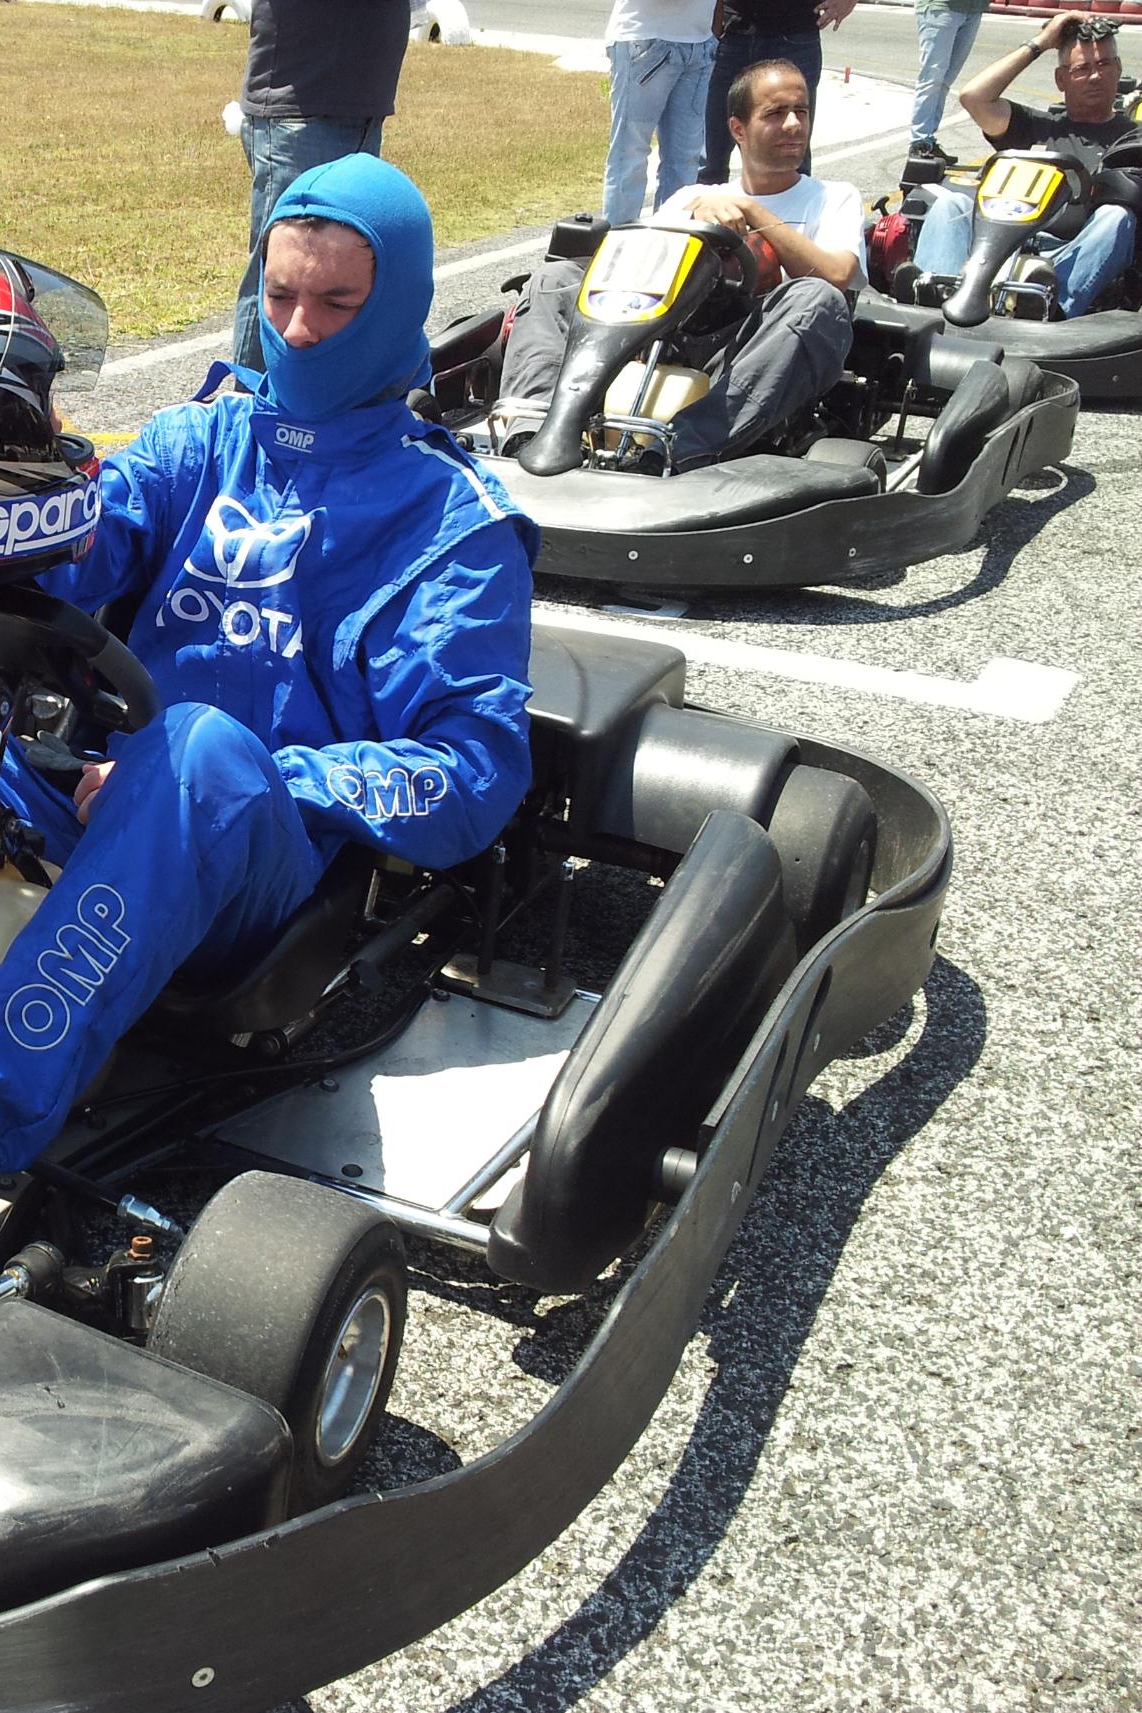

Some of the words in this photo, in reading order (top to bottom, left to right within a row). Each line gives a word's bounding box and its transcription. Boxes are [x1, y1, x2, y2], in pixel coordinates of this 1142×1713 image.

[997, 165, 1044, 198] 11
[275, 427, 315, 449] OMP
[155, 587, 304, 660] OYOTA
[327, 764, 448, 819] OMP
[4, 883, 132, 1051] OMP
